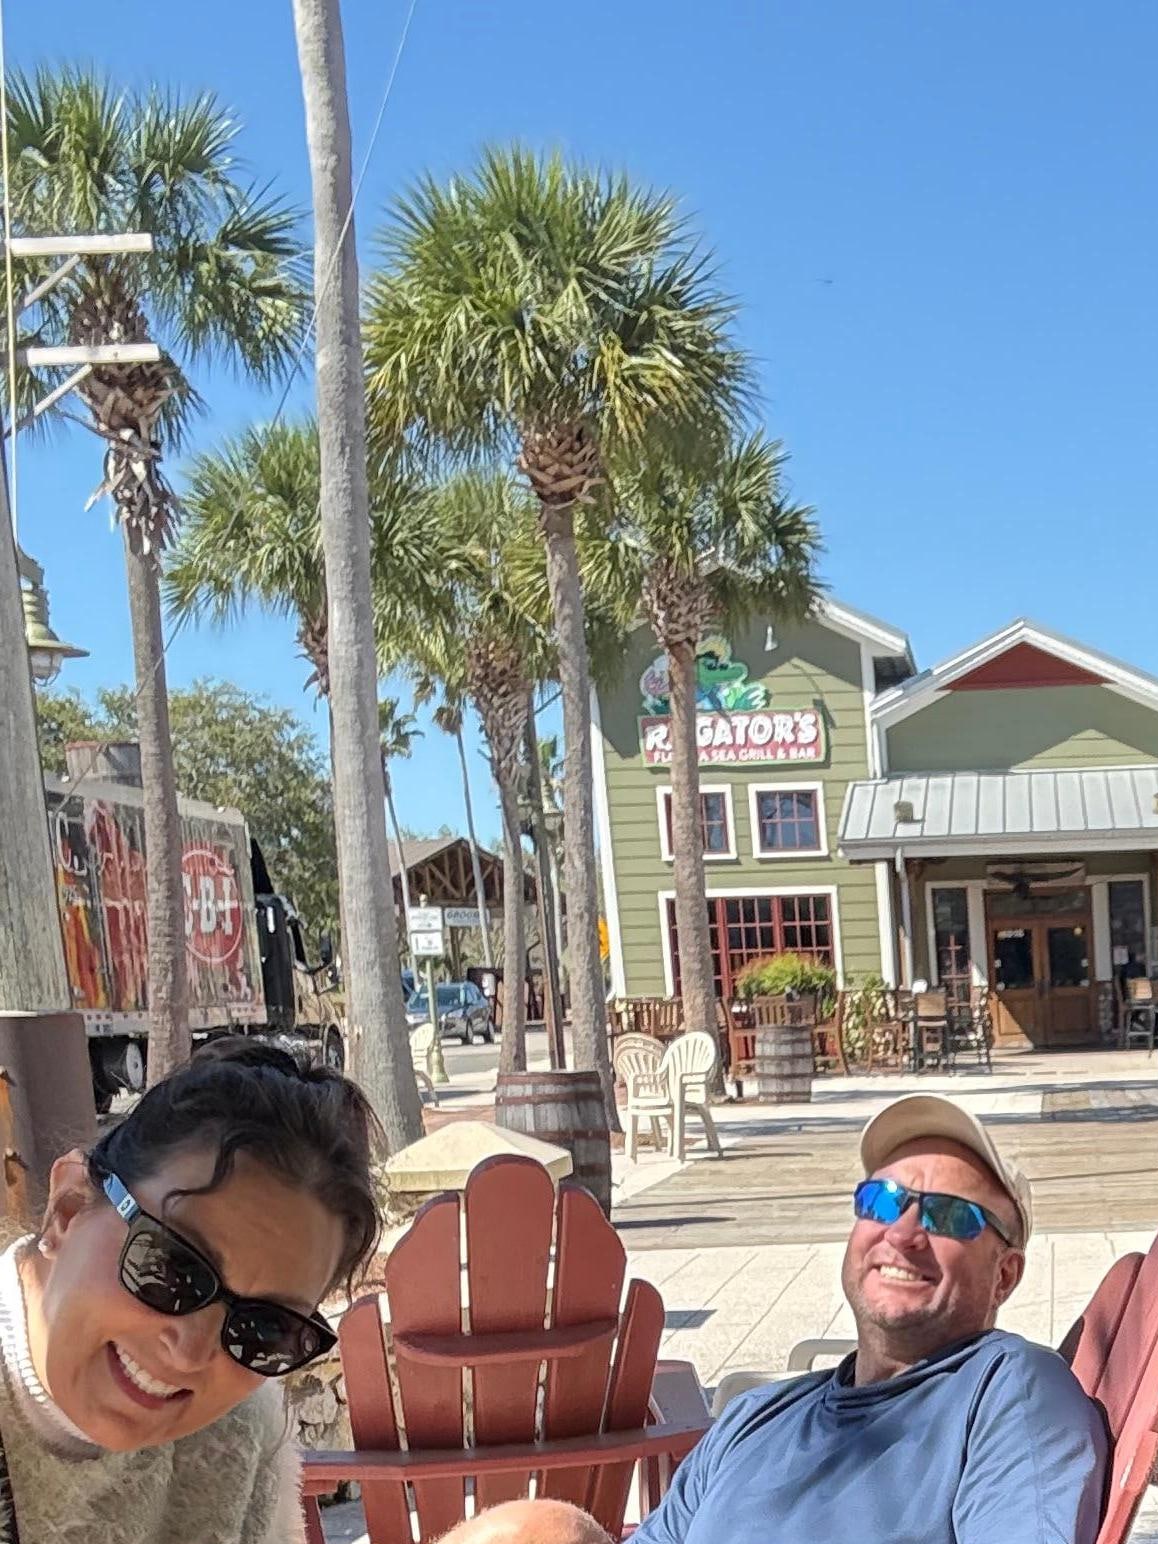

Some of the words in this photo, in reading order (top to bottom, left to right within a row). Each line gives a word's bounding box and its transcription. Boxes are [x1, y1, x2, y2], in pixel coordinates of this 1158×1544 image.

[738, 747, 775, 762] GRILL
[776, 747, 787, 760] &
[788, 746, 816, 760] BAR
